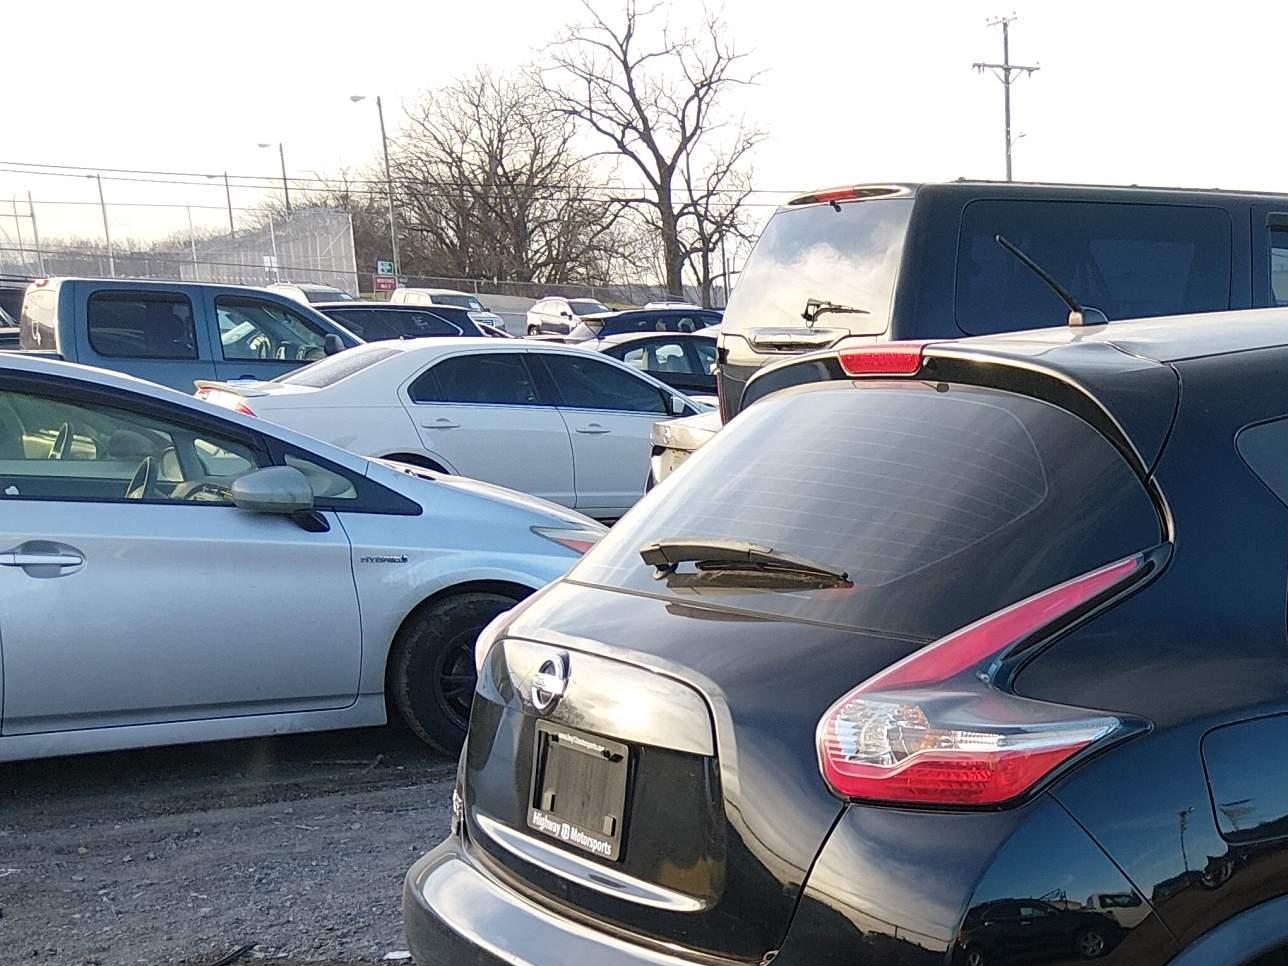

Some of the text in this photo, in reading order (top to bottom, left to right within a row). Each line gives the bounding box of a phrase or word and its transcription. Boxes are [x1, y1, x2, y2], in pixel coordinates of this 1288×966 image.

[360, 555, 401, 563] HYBRID
[532, 811, 561, 837] Highway
[570, 826, 612, 856] Motorsports
